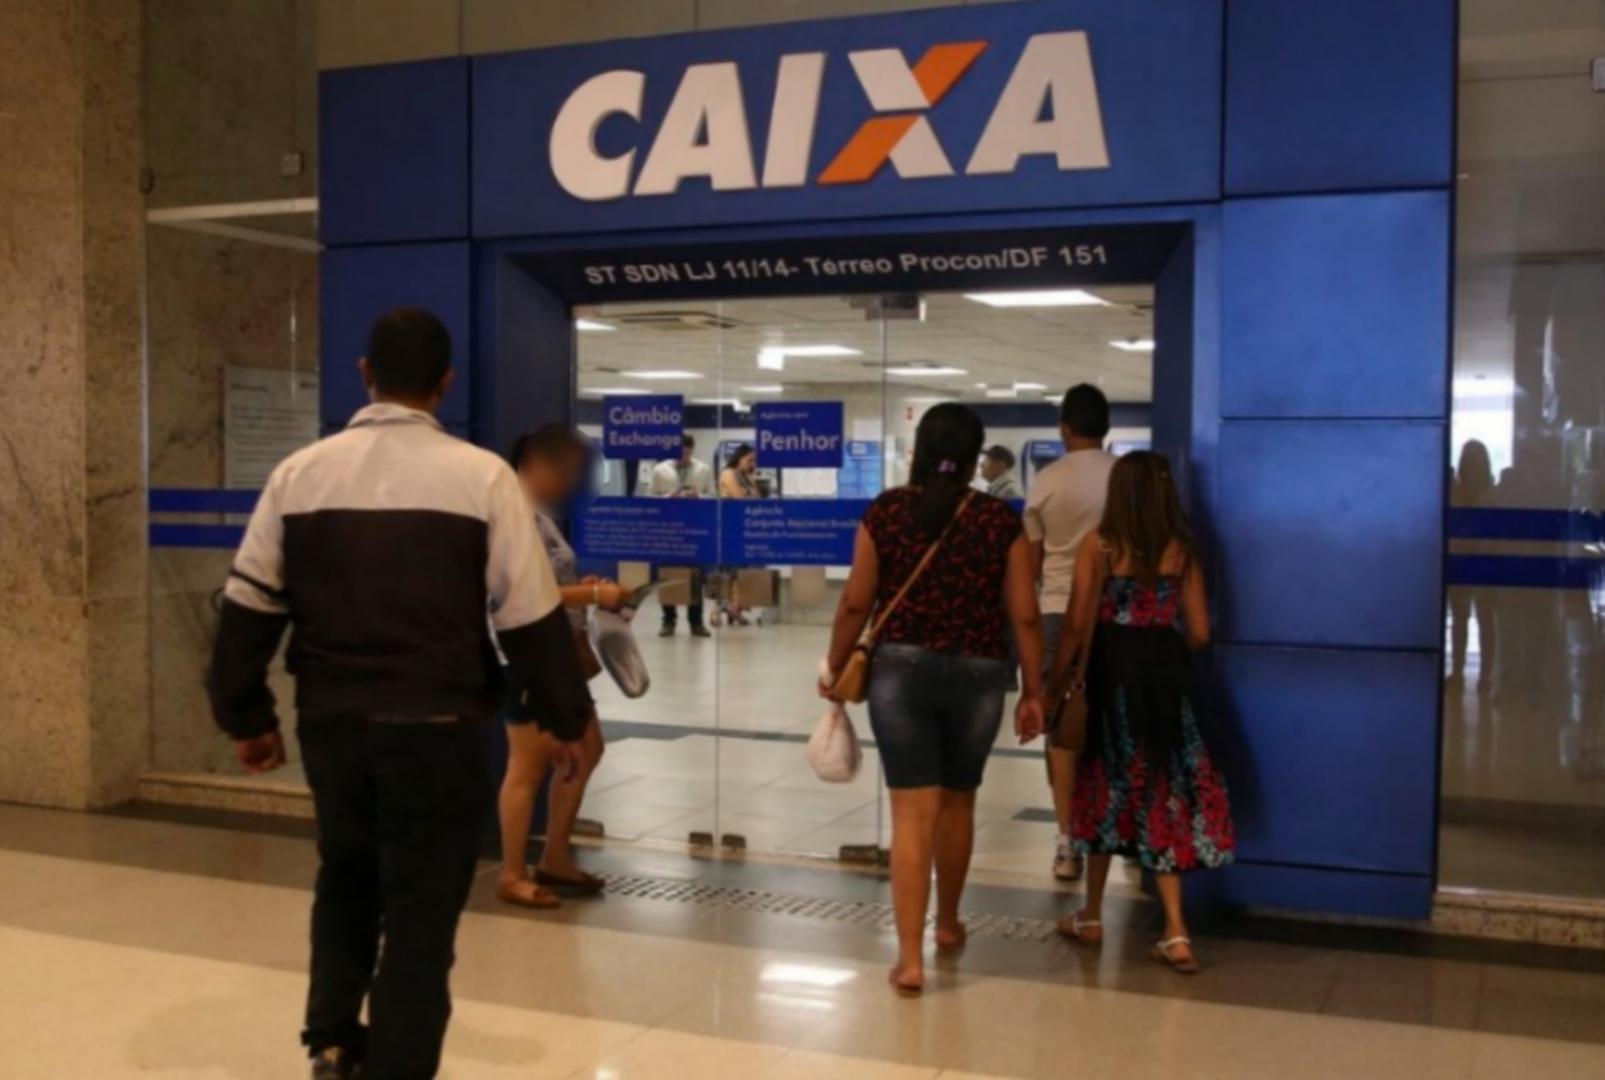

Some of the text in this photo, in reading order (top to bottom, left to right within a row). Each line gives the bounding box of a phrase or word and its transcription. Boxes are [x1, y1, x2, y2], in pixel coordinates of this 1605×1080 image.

[549, 30, 1111, 202] CAIXA
[584, 266, 617, 285] ST
[625, 263, 679, 283] SDN
[684, 262, 715, 281] LJ
[900, 247, 1049, 272] Procon/DF
[1059, 245, 1108, 267] 151
[609, 406, 682, 426] Câmbio
[609, 431, 682, 449] Exchange
[760, 430, 840, 451] Penhor
